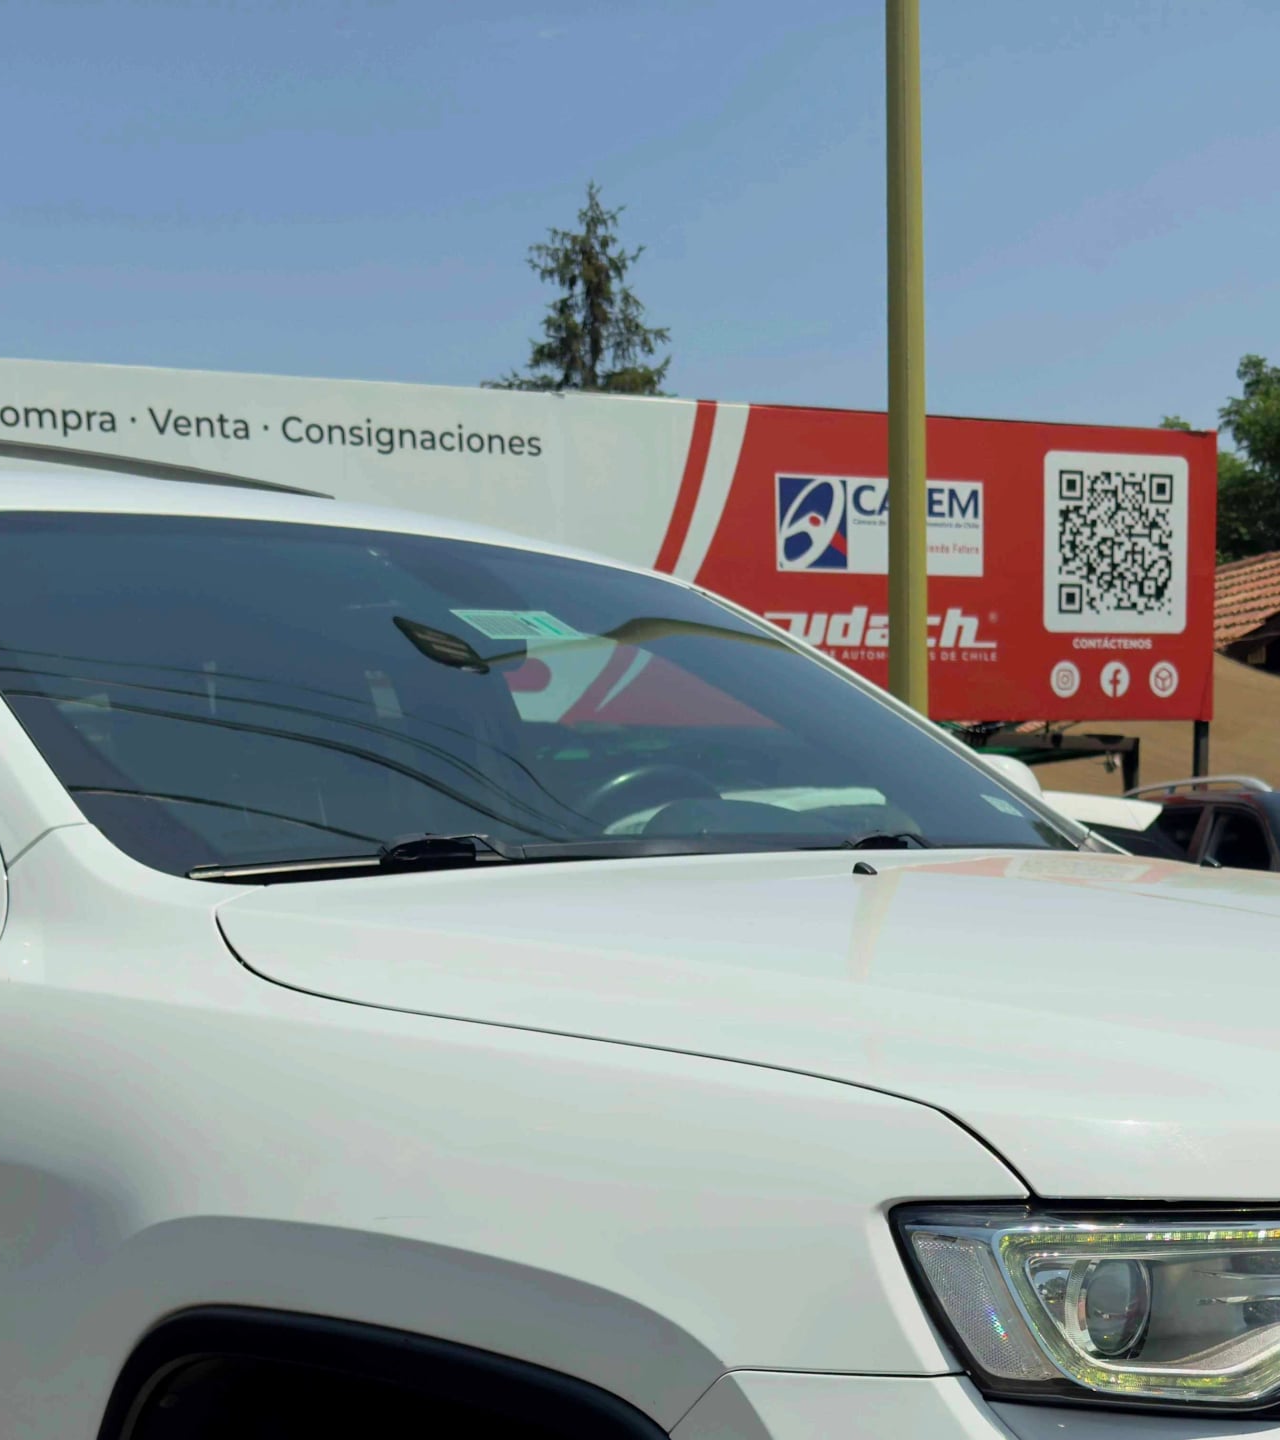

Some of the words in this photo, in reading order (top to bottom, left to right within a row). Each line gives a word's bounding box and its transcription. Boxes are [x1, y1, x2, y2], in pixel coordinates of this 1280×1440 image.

[148, 407, 250, 440] Venta
[281, 415, 542, 457] Consignaciones
[851, 484, 979, 519] CEM
[1072, 635, 1152, 650] CONTÁCTENOS
[842, 650, 936, 661] AUTOMS
[940, 651, 958, 662] DE
[962, 652, 997, 662] CHILE
